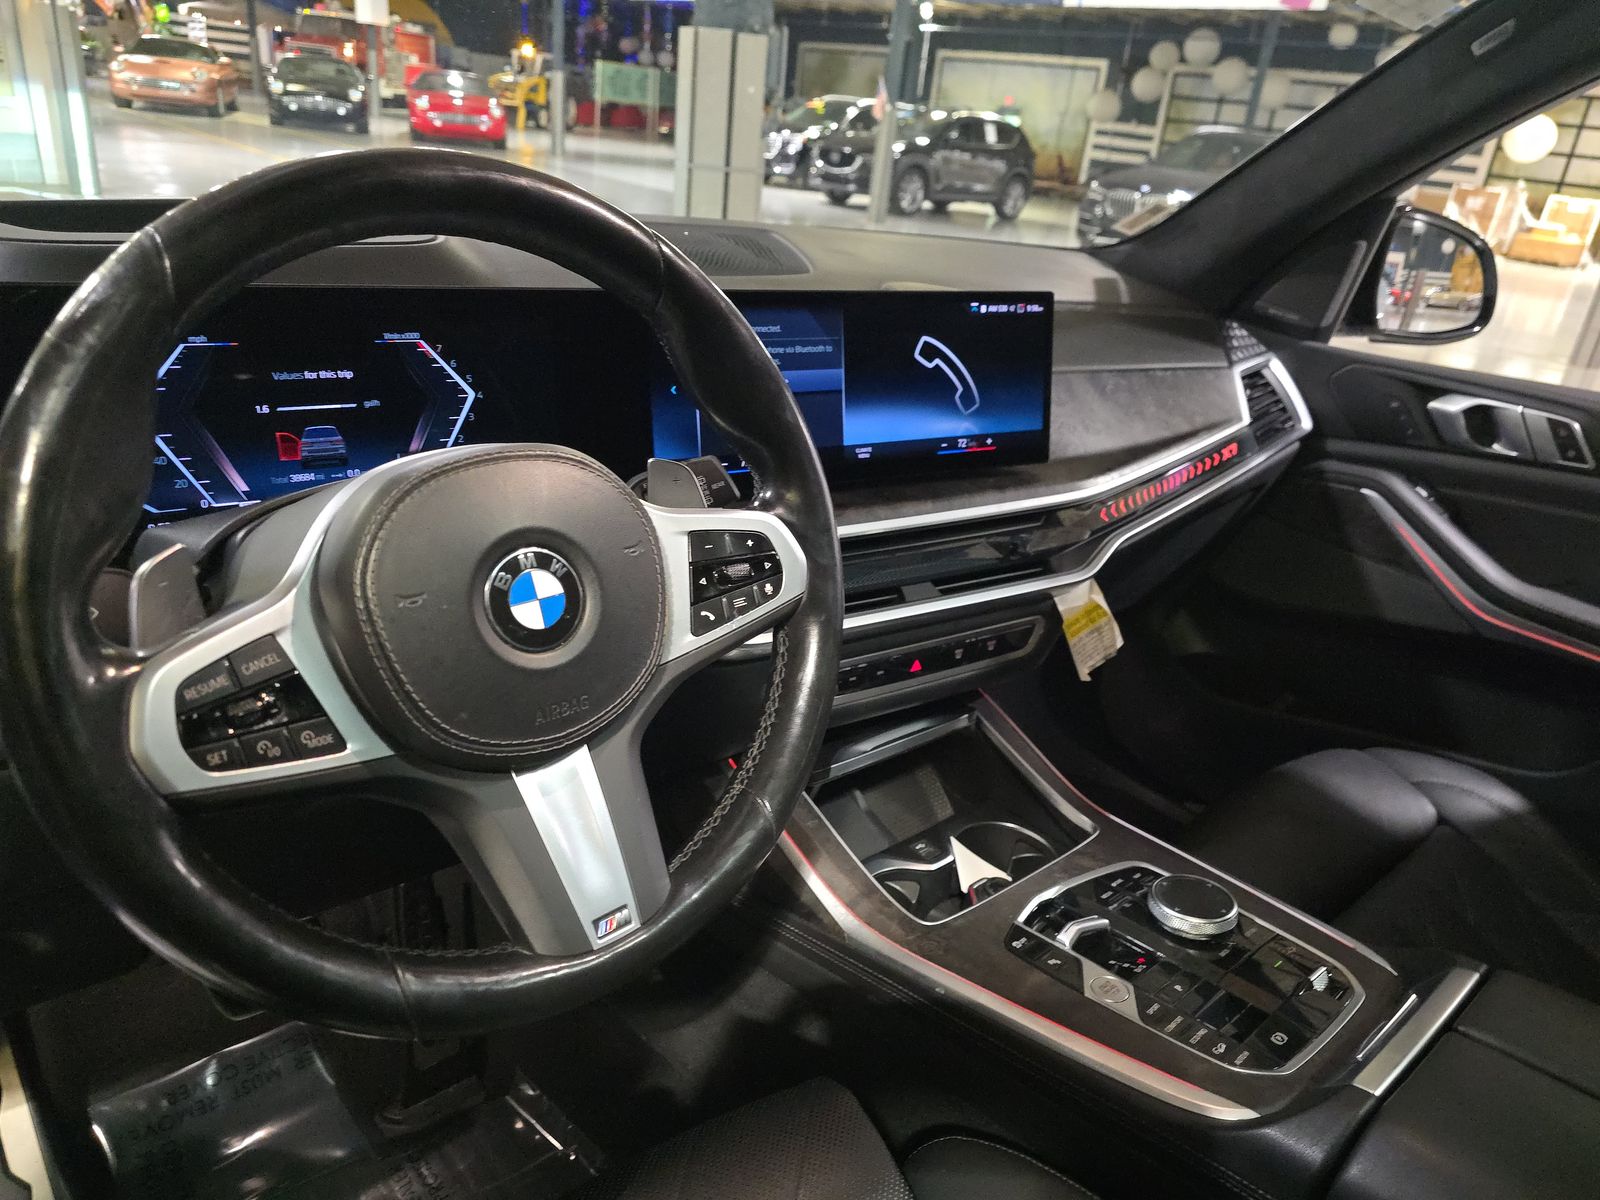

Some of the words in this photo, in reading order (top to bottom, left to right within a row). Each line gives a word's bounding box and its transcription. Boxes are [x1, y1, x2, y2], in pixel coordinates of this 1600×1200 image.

[435, 344, 443, 353] 7
[795, 345, 825, 353] Bluetooth
[450, 359, 457, 368] 6
[272, 371, 304, 381] Values
[304, 370, 319, 380] for
[319, 370, 337, 379] this
[337, 369, 354, 380] trip
[466, 374, 473, 383] 5
[476, 391, 484, 399] 4
[254, 404, 270, 414] 1.6
[468, 412, 475, 421] 3
[457, 434, 464, 443] 2
[174, 479, 189, 489] 20
[200, 499, 209, 509] 0
[494, 552, 567, 591] BMW
[241, 653, 281, 676] CANCEL
[183, 673, 229, 701] RESUME
[535, 695, 591, 726] AIRBAG
[206, 749, 228, 767] SET
